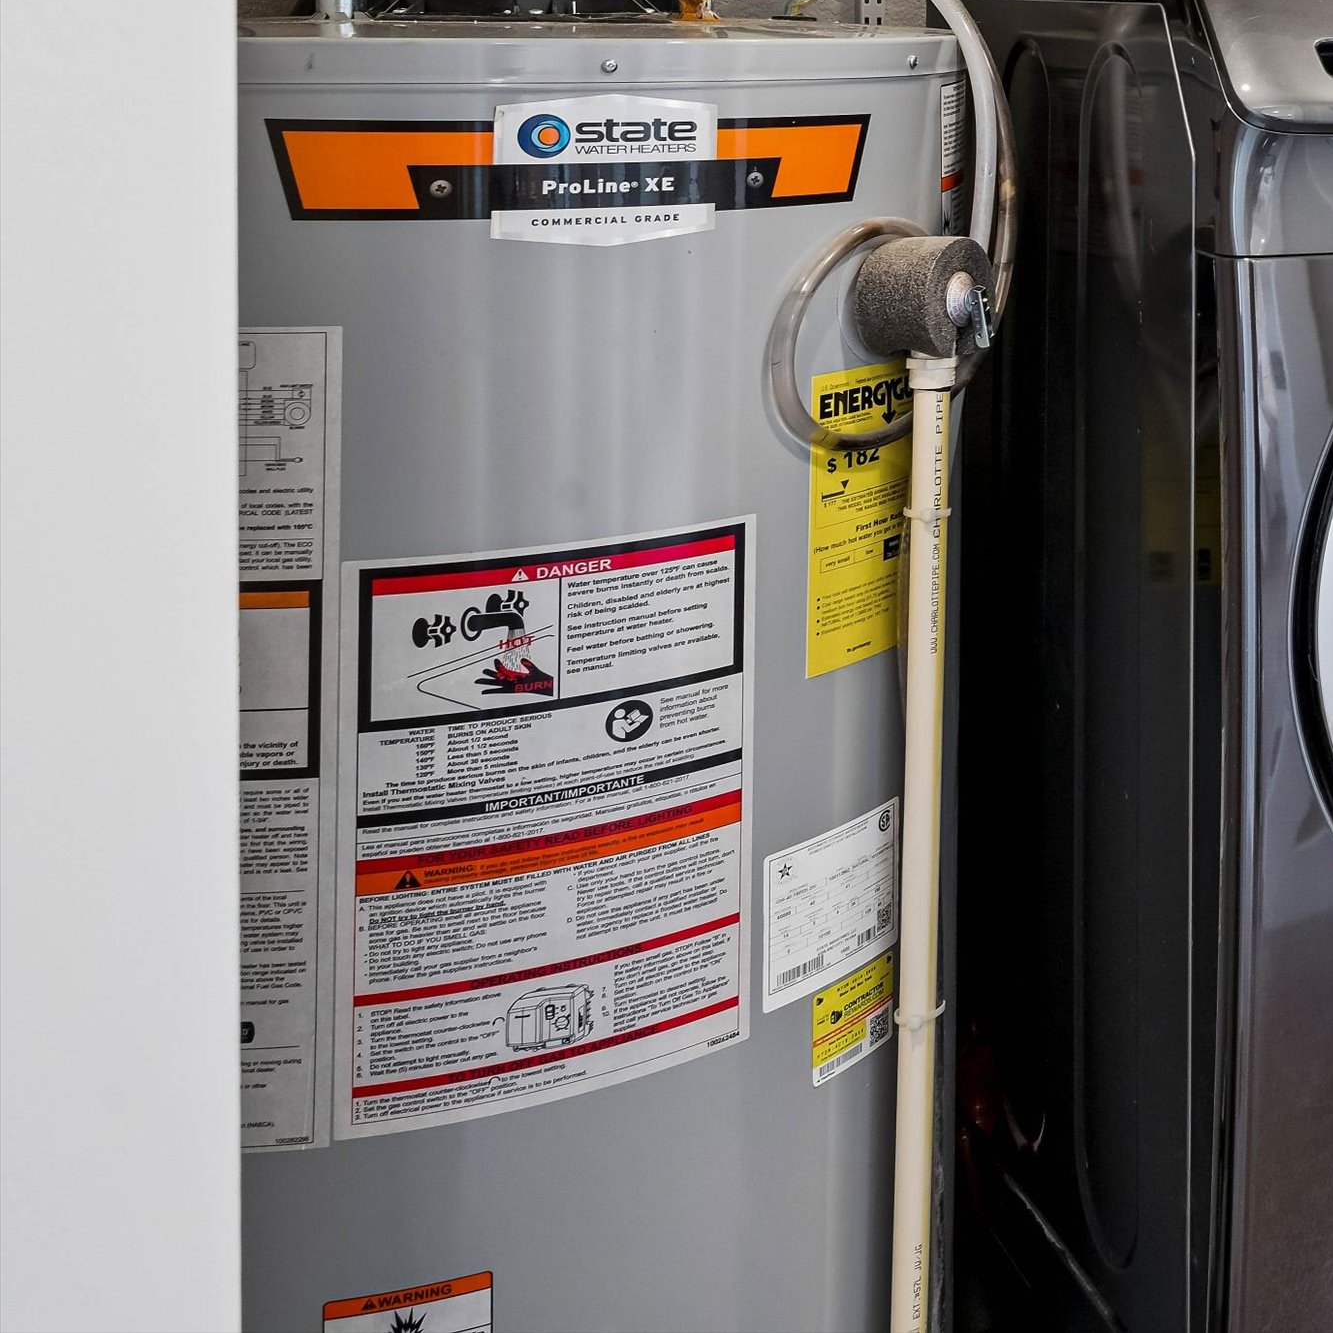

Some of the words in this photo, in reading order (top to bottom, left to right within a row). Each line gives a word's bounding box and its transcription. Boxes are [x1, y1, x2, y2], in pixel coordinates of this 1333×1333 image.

[575, 118, 697, 143] state
[575, 145, 627, 154] WATER
[630, 144, 696, 153] HEATERS
[645, 177, 675, 191] XE
[531, 216, 627, 226] COMMERCIAL
[635, 214, 680, 223] GRADE
[935, 392, 945, 434] PIPE
[827, 458, 837, 473] $
[932, 444, 943, 539] CHRLOTTE
[856, 523, 872, 532] First
[873, 518, 889, 527] Hour
[831, 540, 846, 549] much
[858, 532, 872, 540] water
[536, 559, 611, 579] DANGER
[567, 580, 590, 589] Water
[593, 573, 639, 586] temperature
[642, 570, 658, 578] over
[697, 560, 718, 568] cause
[567, 589, 594, 597] severe
[596, 584, 619, 593] burns
[621, 579, 653, 590] instantly
[666, 573, 685, 582] death
[688, 570, 704, 578] from
[706, 565, 730, 575] scalds.
[567, 600, 603, 610] Children,
[606, 594, 638, 604] disabled
[656, 587, 680, 596] elderly
[705, 577, 730, 588] highest
[567, 610, 583, 618] risk
[585, 608, 593, 616] of
[594, 606, 617, 615] being
[618, 601, 650, 610] scalded.
[584, 618, 626, 629] instruction
[629, 612, 656, 622] manual
[658, 608, 682, 617] before
[683, 602, 708, 613] setting
[567, 627, 615, 640] temperature
[626, 622, 647, 631] water
[649, 617, 674, 627] heater.
[567, 645, 584, 653] Feel
[586, 642, 608, 651] water
[610, 637, 634, 647] before
[636, 631, 664, 642] bathing
[676, 622, 715, 634] showering.
[567, 653, 616, 666] Temperature
[618, 647, 647, 658] limiting
[649, 643, 672, 653] valves
[687, 633, 720, 645] available,
[583, 662, 614, 672] manual.
[515, 680, 553, 693] BURN
[675, 690, 701, 700] manual
[712, 684, 729, 693] more
[659, 699, 698, 712] information
[699, 695, 718, 703] about
[480, 718, 518, 728] PRODUCE
[520, 712, 552, 722] SERIOUS
[659, 709, 696, 722] preventing
[697, 704, 716, 712] burns
[677, 717, 688, 725] hot
[409, 728, 435, 736] WATER
[488, 726, 512, 734] ADULT
[379, 735, 435, 746] TEMPERATURE
[362, 789, 389, 798] Install
[390, 785, 446, 796] Thermostatic
[449, 780, 476, 790] Mixing
[478, 776, 505, 786] Valves
[485, 774, 645, 813] IMPORTANT/IMPORTANTE
[424, 865, 476, 877] WARNING:
[844, 982, 884, 1011] CONTRACTOR
[378, 1284, 452, 1308] WARNING
